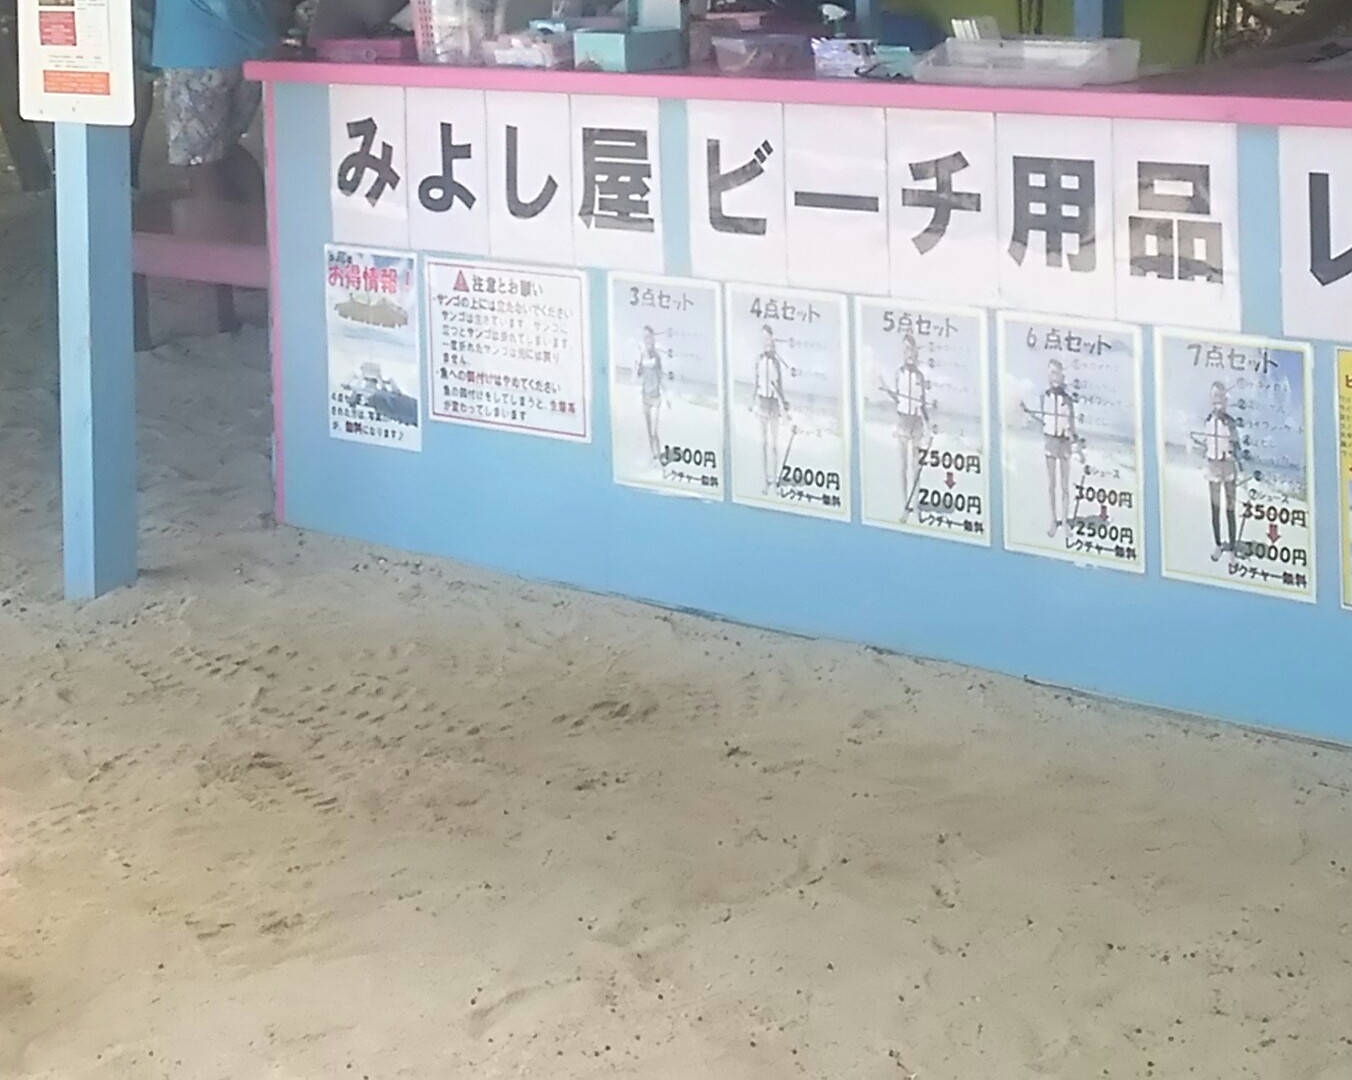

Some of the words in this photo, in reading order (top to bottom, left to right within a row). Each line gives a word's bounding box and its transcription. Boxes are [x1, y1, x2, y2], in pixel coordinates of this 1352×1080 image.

[337, 117, 656, 233] みよし屋
[706, 138, 1225, 284] ビーチ用品
[629, 286, 695, 312] 3点セット
[750, 297, 821, 323] 4点セット
[883, 311, 959, 339] 5点セット
[1026, 328, 1113, 357] 6点セット
[1187, 343, 1279, 375] 7点セット
[664, 445, 718, 470] 1500円
[918, 448, 982, 475] 2500円
[782, 464, 841, 492] 2000円
[918, 488, 983, 515] 2000円
[1074, 485, 1134, 509] 3000円
[1241, 501, 1307, 529] 3500円
[1075, 521, 1135, 545] 2500円
[1242, 541, 1308, 567] 3000円
